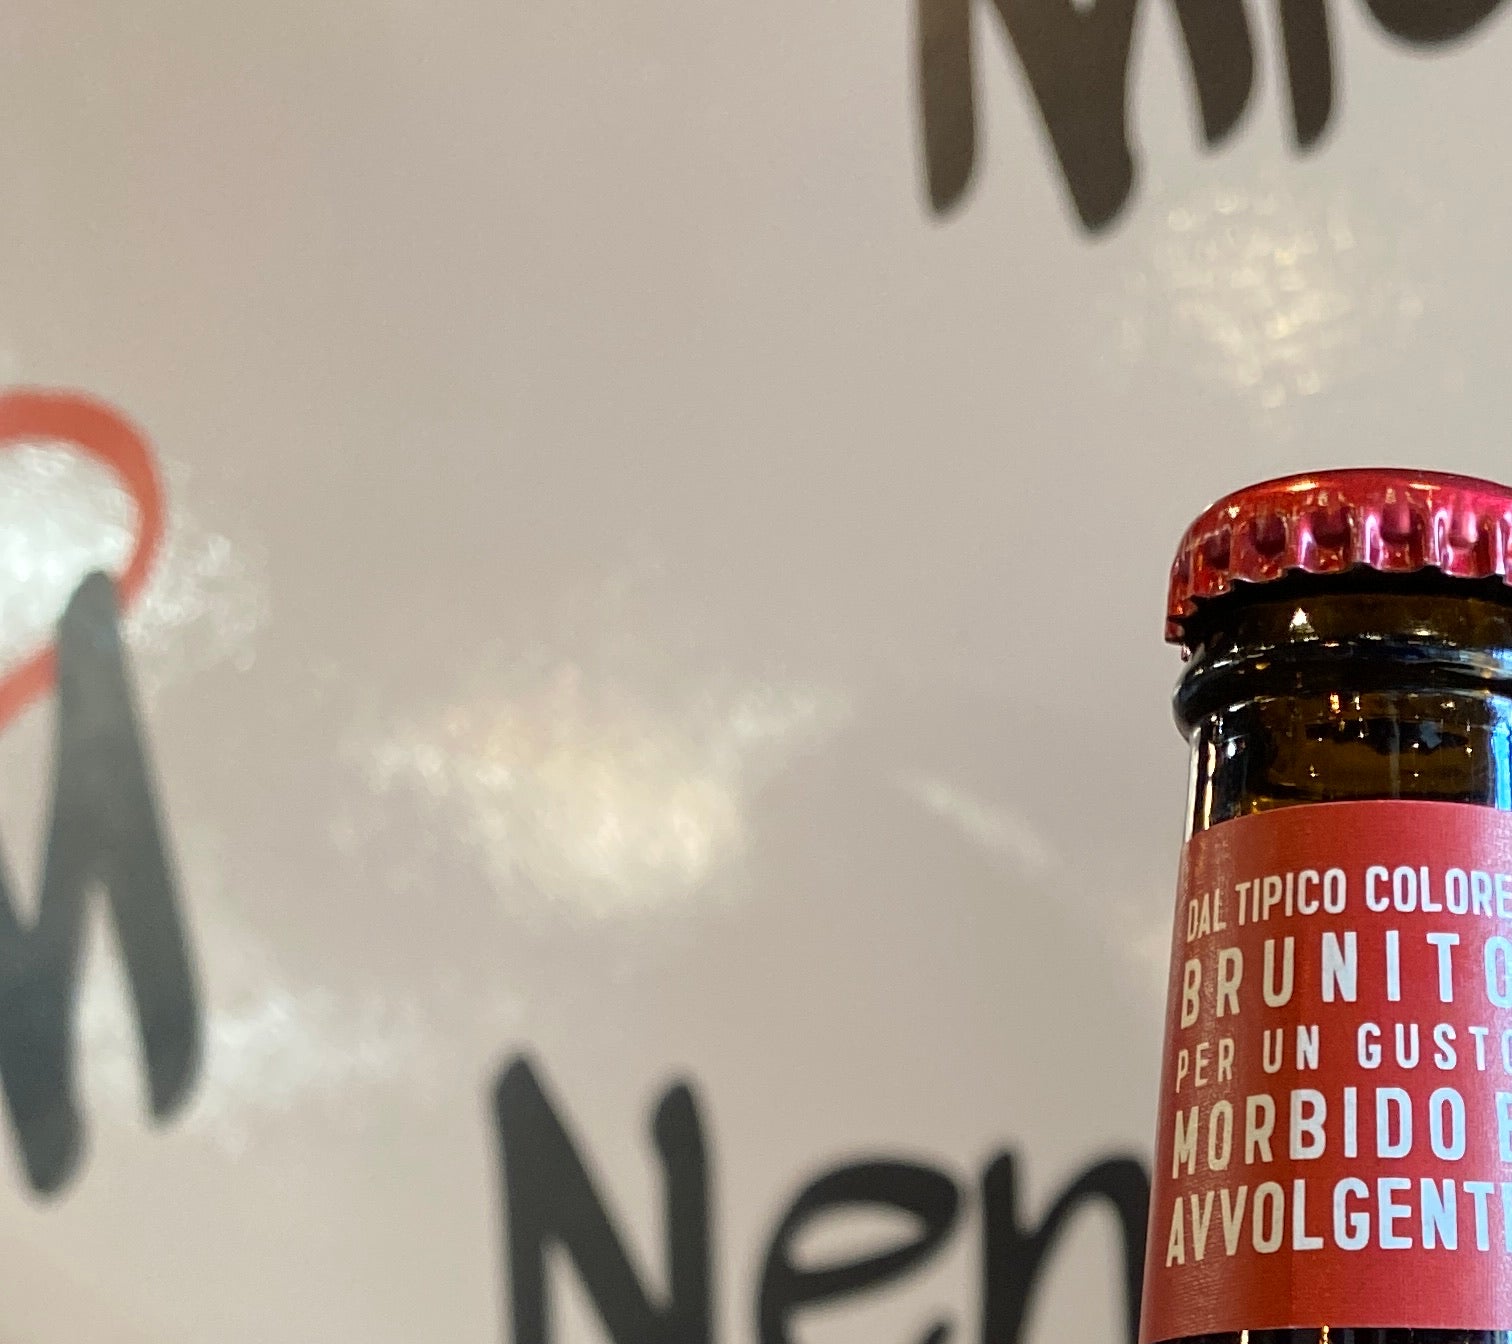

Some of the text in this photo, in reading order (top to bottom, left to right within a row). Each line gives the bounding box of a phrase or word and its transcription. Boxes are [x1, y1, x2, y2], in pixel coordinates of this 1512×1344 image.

[1186, 888, 1227, 944] DAL
[1234, 867, 1347, 927] TIPICO
[1175, 1037, 1236, 1094] PER
[1261, 1023, 1320, 1076] UN
[1171, 1086, 1467, 1180] MORBIDO
